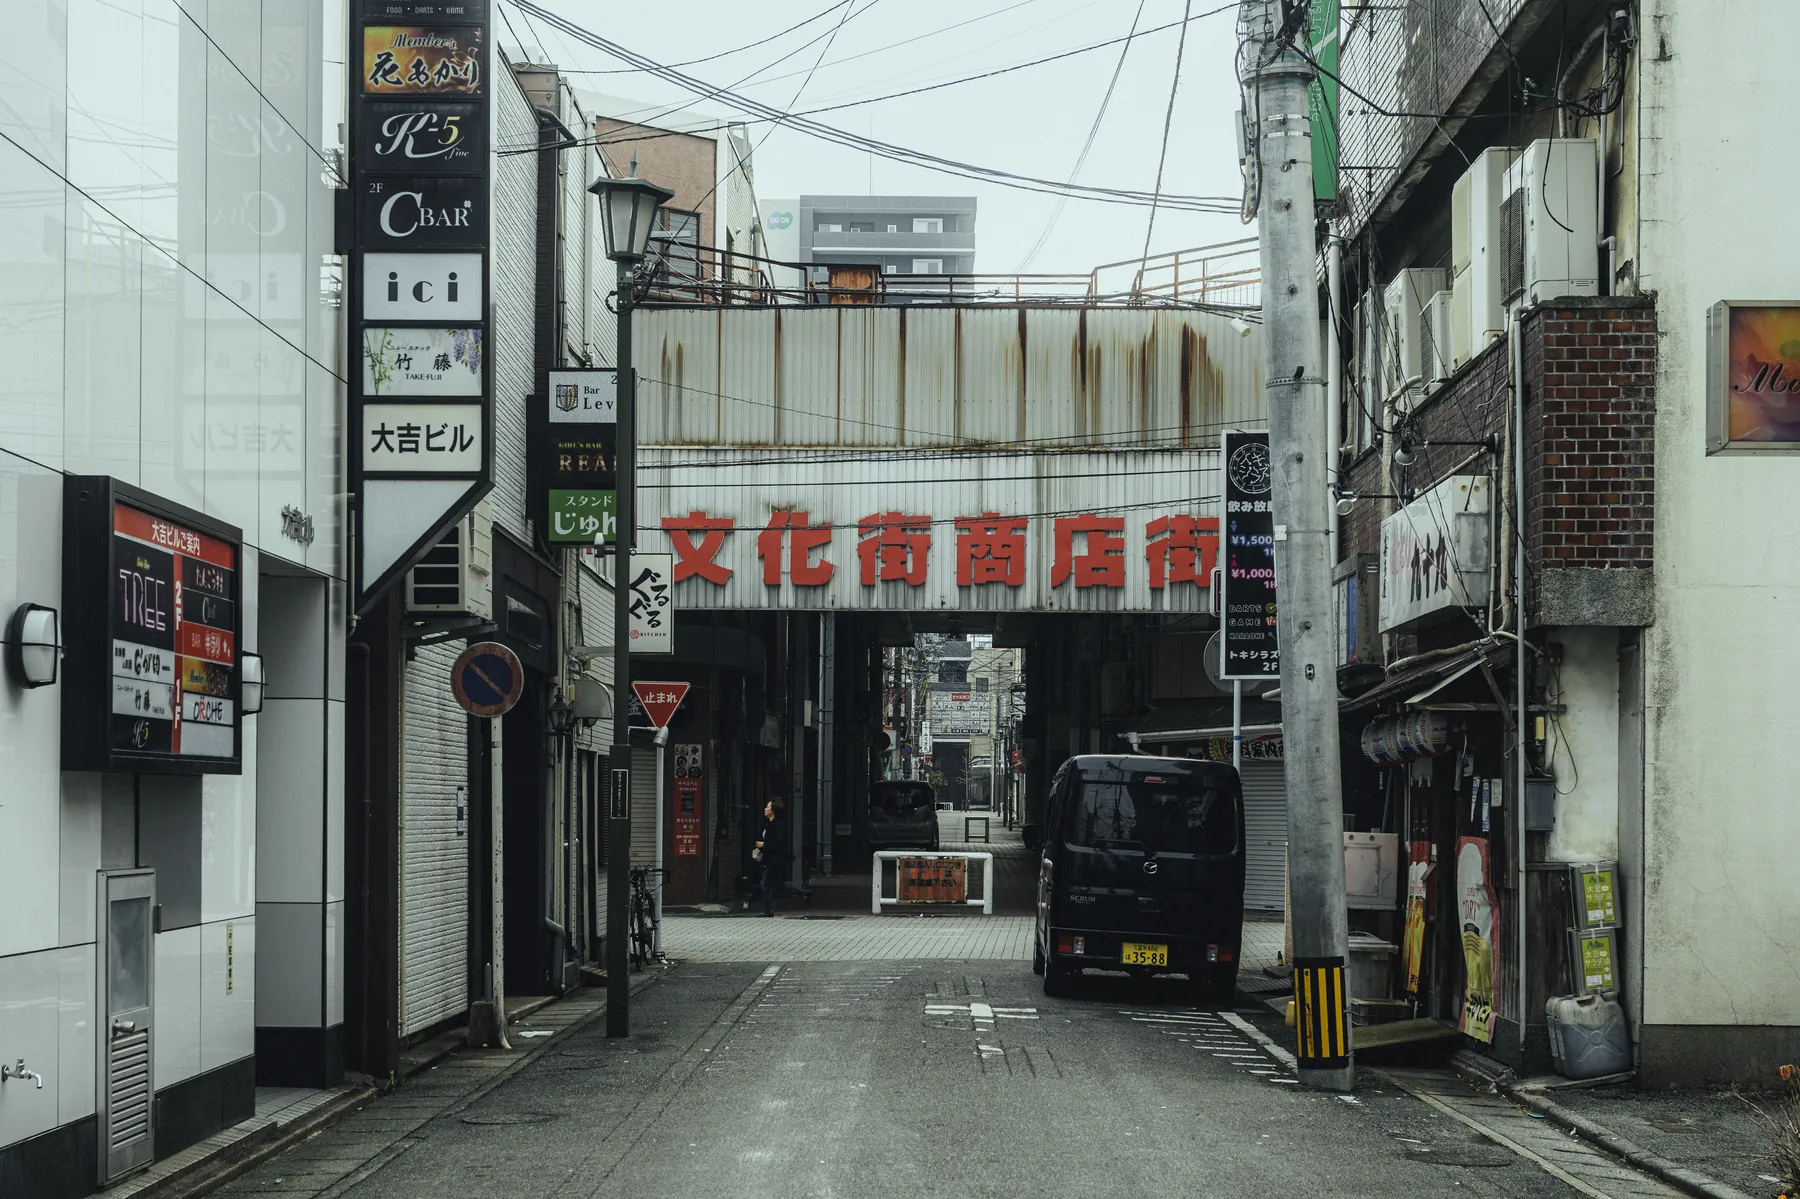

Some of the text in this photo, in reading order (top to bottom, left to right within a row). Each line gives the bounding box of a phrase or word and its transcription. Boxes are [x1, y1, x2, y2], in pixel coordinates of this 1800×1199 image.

[386, 6, 465, 15] FOOD DARTS GAME
[368, 52, 480, 86] 花あかり
[444, 147, 469, 160] five
[369, 183, 383, 193] 2F
[388, 271, 458, 302] ici
[584, 386, 600, 395] Bar
[371, 422, 475, 453] 大吉ビル
[558, 454, 617, 472] REA
[565, 495, 612, 507] スタンド
[152, 520, 200, 556] 大吉ビルご案内
[1231, 536, 1275, 546] ¥1,500
[661, 511, 1219, 589] 文化街商店街
[120, 569, 165, 631] TREE
[175, 581, 182, 630] 2F
[1229, 618, 1261, 626] GAME
[1230, 651, 1280, 660] トキシラズ
[1263, 662, 1278, 671] 2F
[174, 679, 181, 729] 1F
[644, 691, 678, 704] 止まれ
[1133, 951, 1165, 964] 35-88
